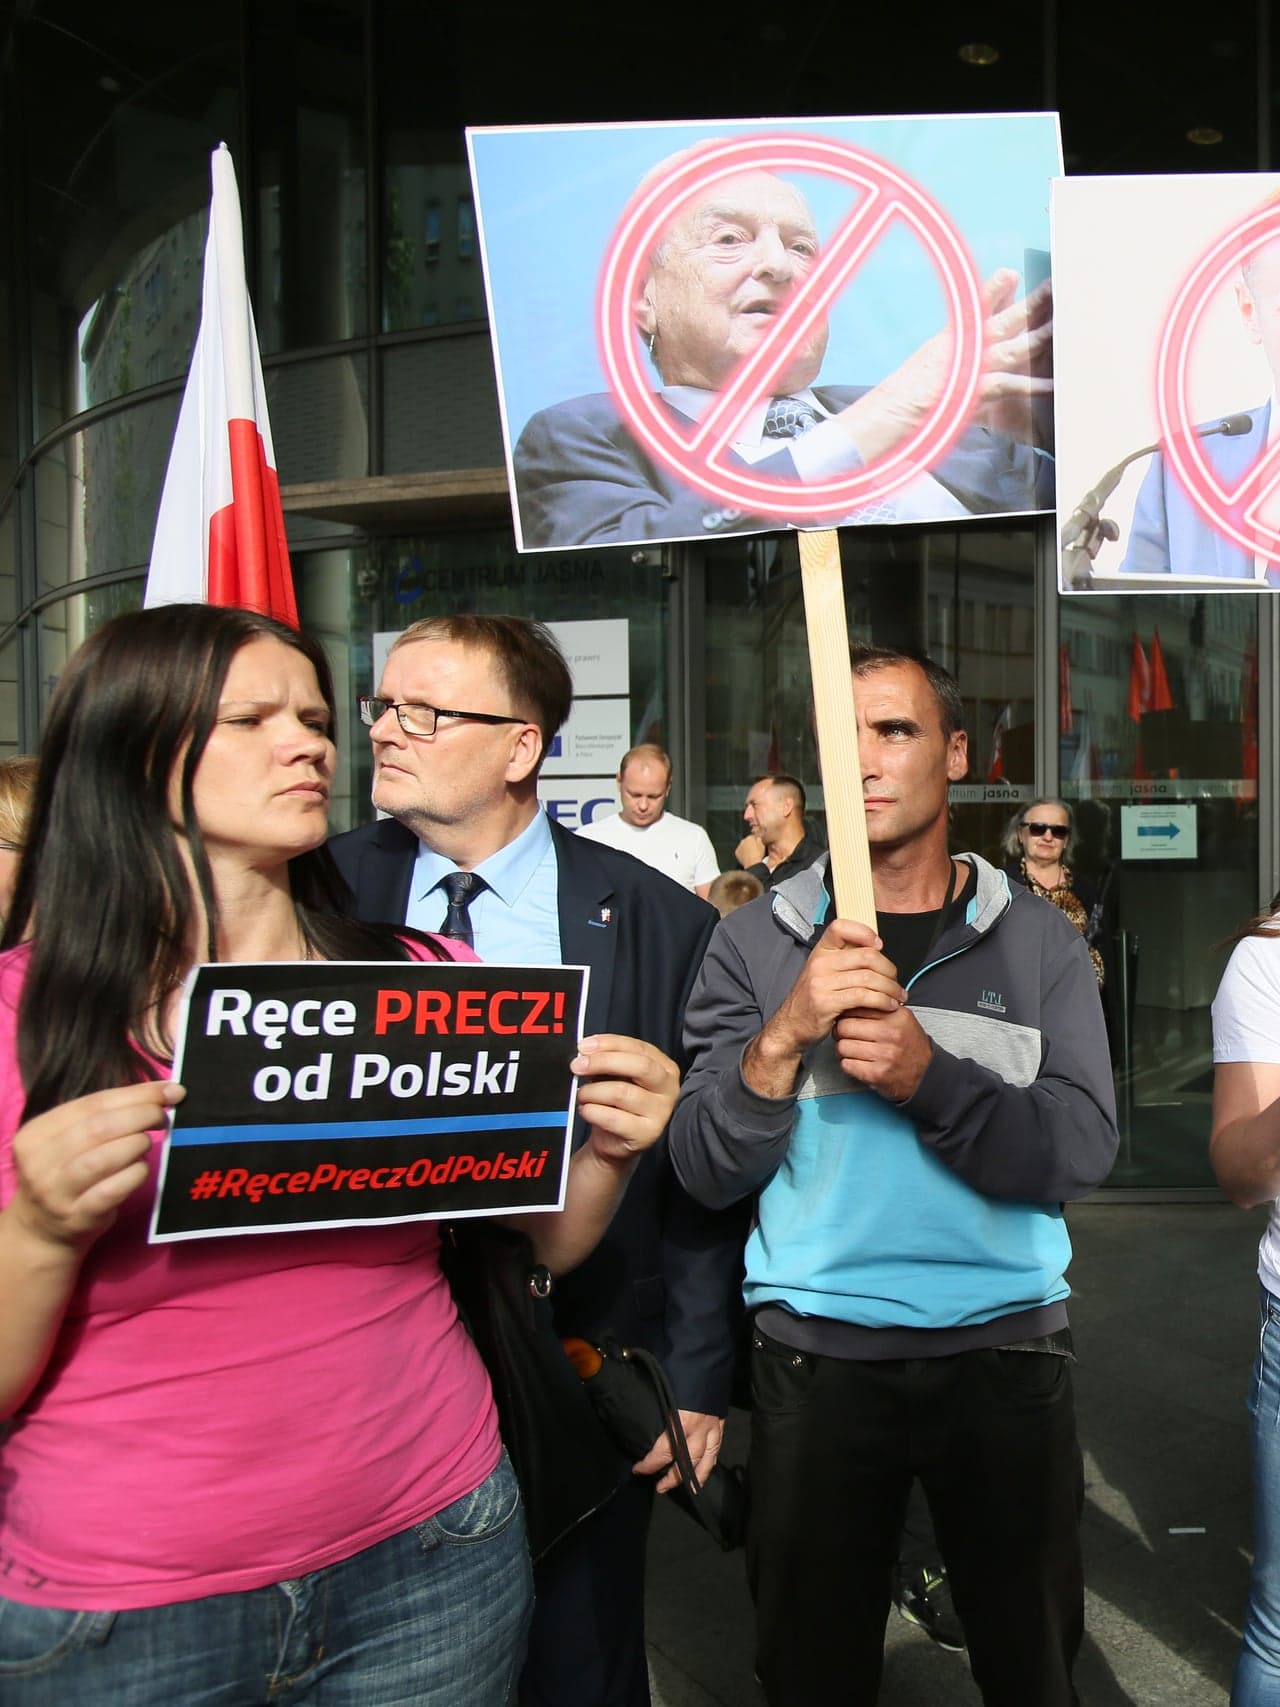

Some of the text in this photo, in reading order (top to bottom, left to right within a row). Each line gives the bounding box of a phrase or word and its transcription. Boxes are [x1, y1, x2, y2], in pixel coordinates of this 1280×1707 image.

[532, 559, 606, 584] JASNA
[982, 786, 1019, 800] jasna
[1130, 782, 1167, 795] jasna
[205, 988, 567, 1049] Ręce PRECZ!
[252, 1050, 521, 1102] od Polski
[189, 1150, 550, 1203] #RęcePreczOdPolski
